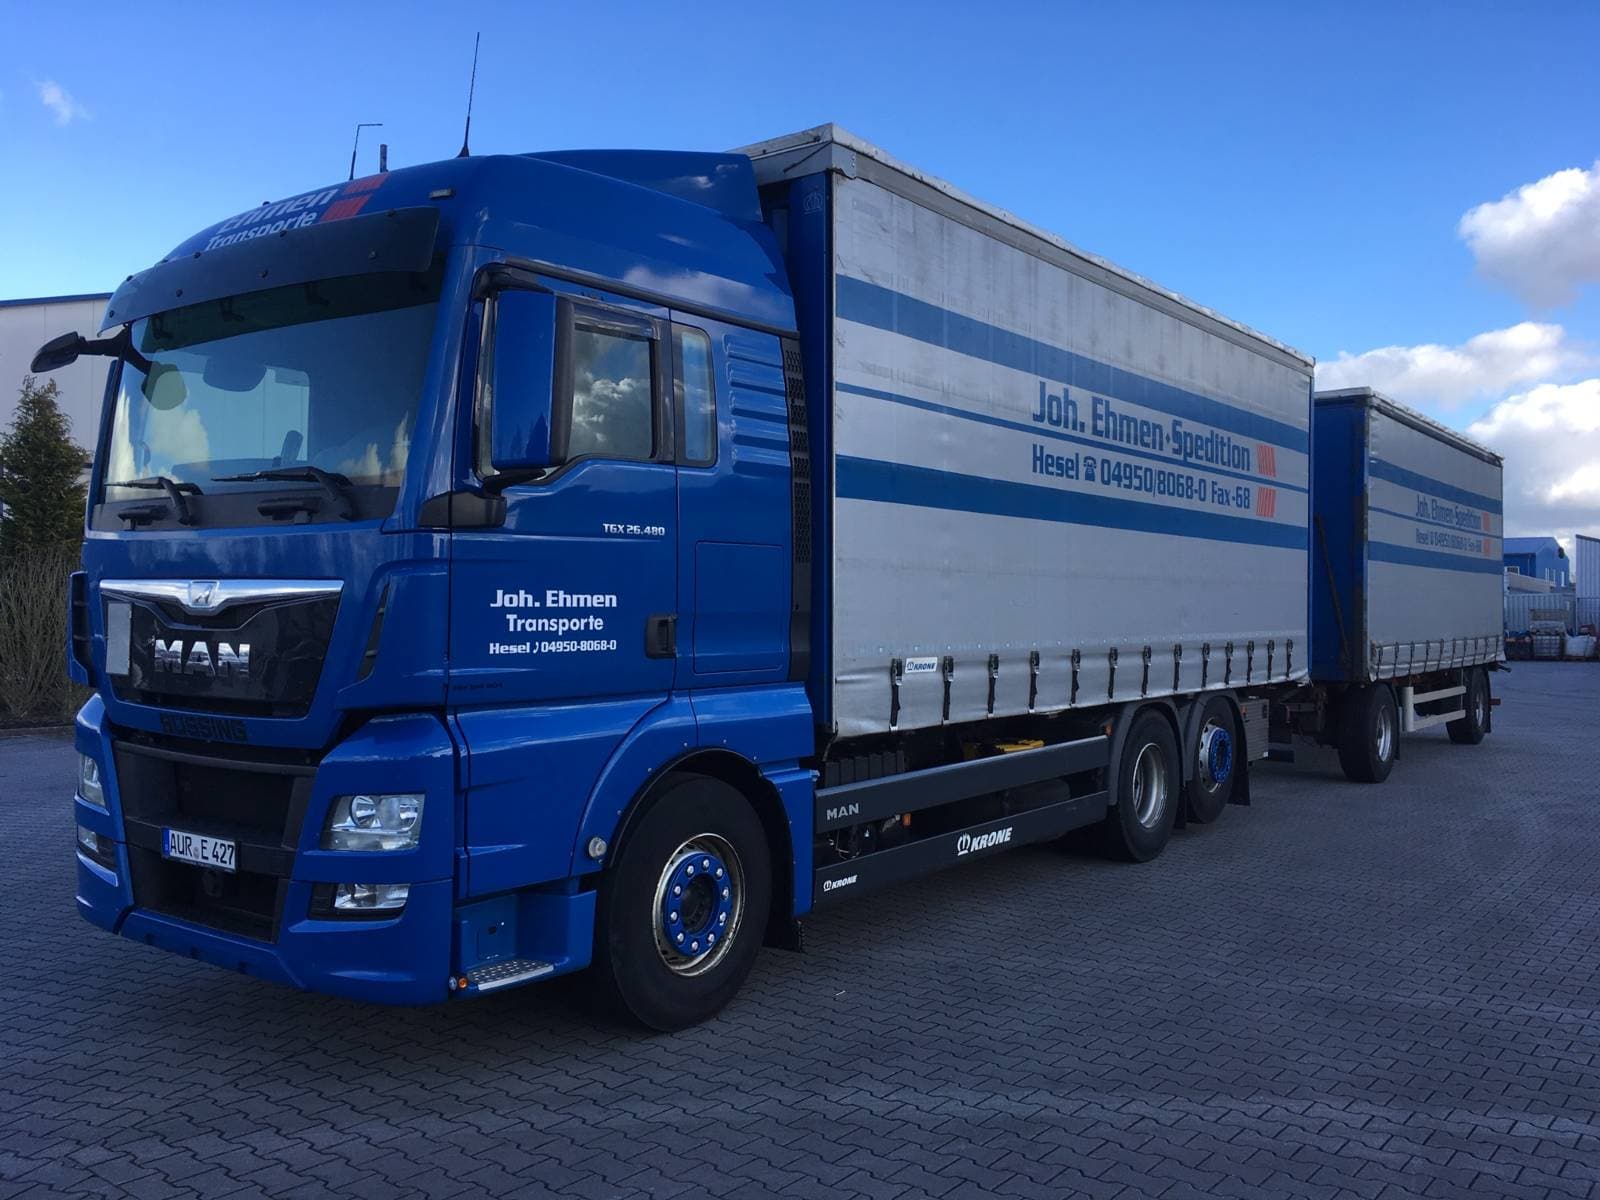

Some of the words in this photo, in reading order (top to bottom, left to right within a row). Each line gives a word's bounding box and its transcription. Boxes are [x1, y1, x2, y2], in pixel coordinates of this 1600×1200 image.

[1032, 381, 1085, 433] Joh.
[1092, 396, 1164, 451] Ehmen
[1032, 443, 1079, 480] Hesel
[603, 523, 625, 534] TGX
[626, 525, 665, 536] 26.480
[490, 589, 540, 607] Joh.
[546, 590, 617, 608] Ehmen
[506, 614, 604, 635] Transporte
[489, 641, 530, 654] Hesel
[153, 638, 251, 679] MAN
[914, 662, 937, 670] KRONE
[826, 803, 859, 821] MAN
[171, 833, 192, 857] AUR
[201, 839, 209, 860] E
[212, 841, 235, 865] 427
[970, 827, 1013, 852] KRONE
[832, 874, 857, 890] KRONE
